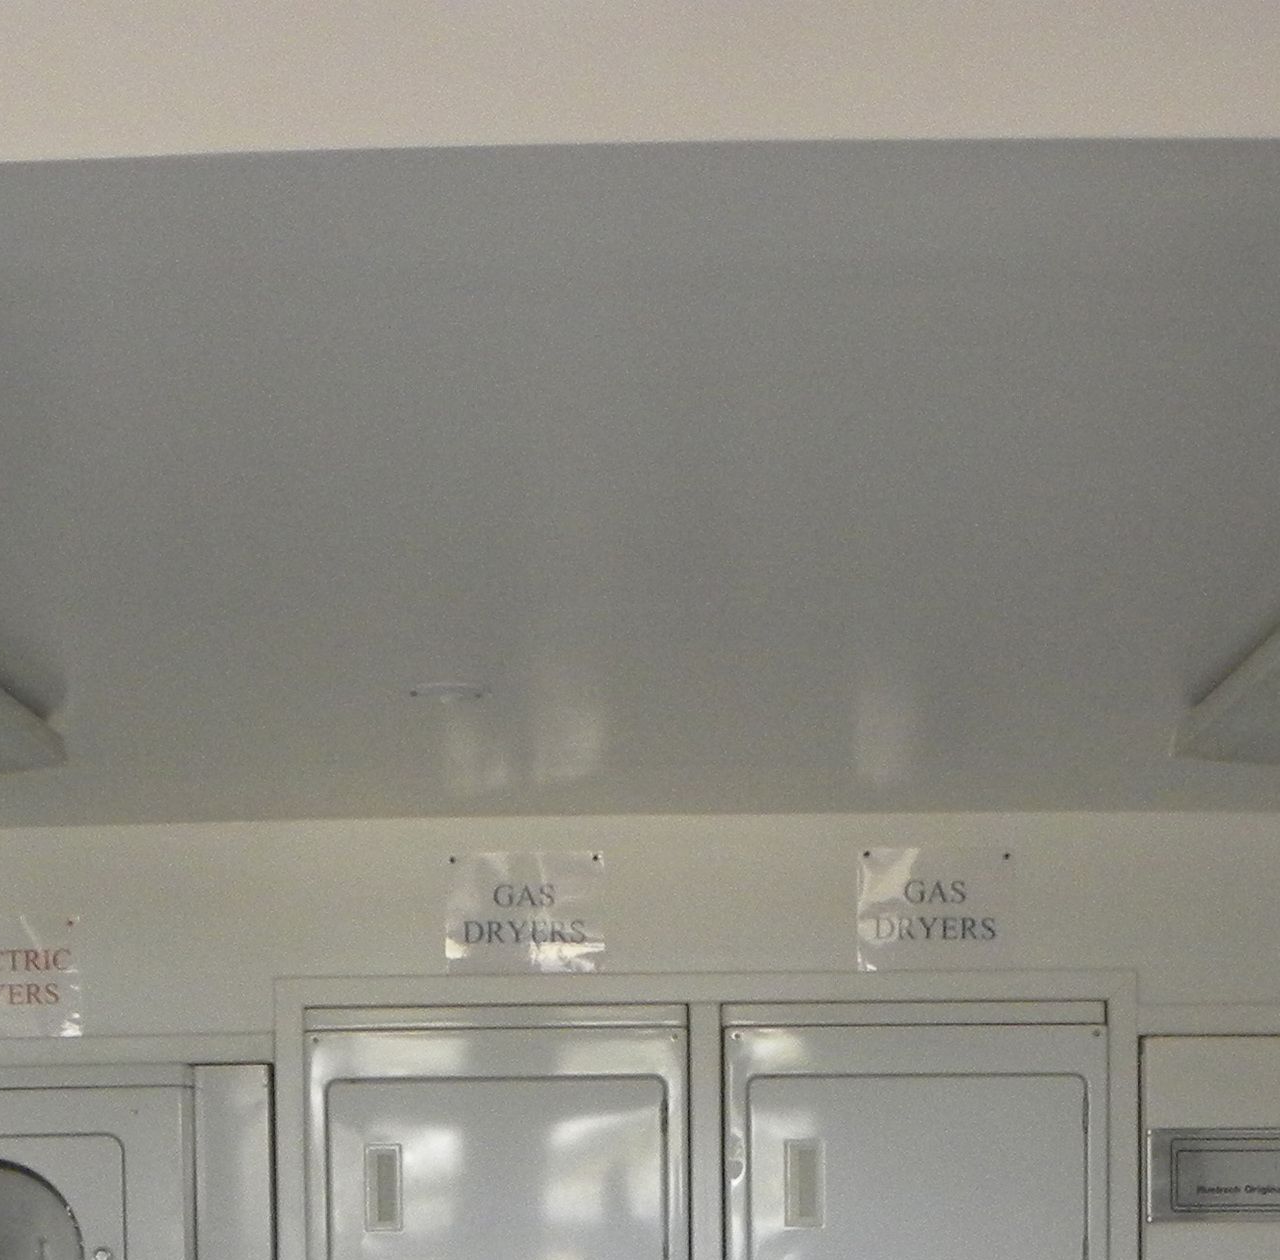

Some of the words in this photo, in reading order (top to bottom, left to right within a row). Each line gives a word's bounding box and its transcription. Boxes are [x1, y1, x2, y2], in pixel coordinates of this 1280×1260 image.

[493, 884, 555, 908] GAS
[904, 880, 967, 904] GAS
[463, 919, 587, 945] DRYERS
[875, 916, 997, 940] DRYERS
